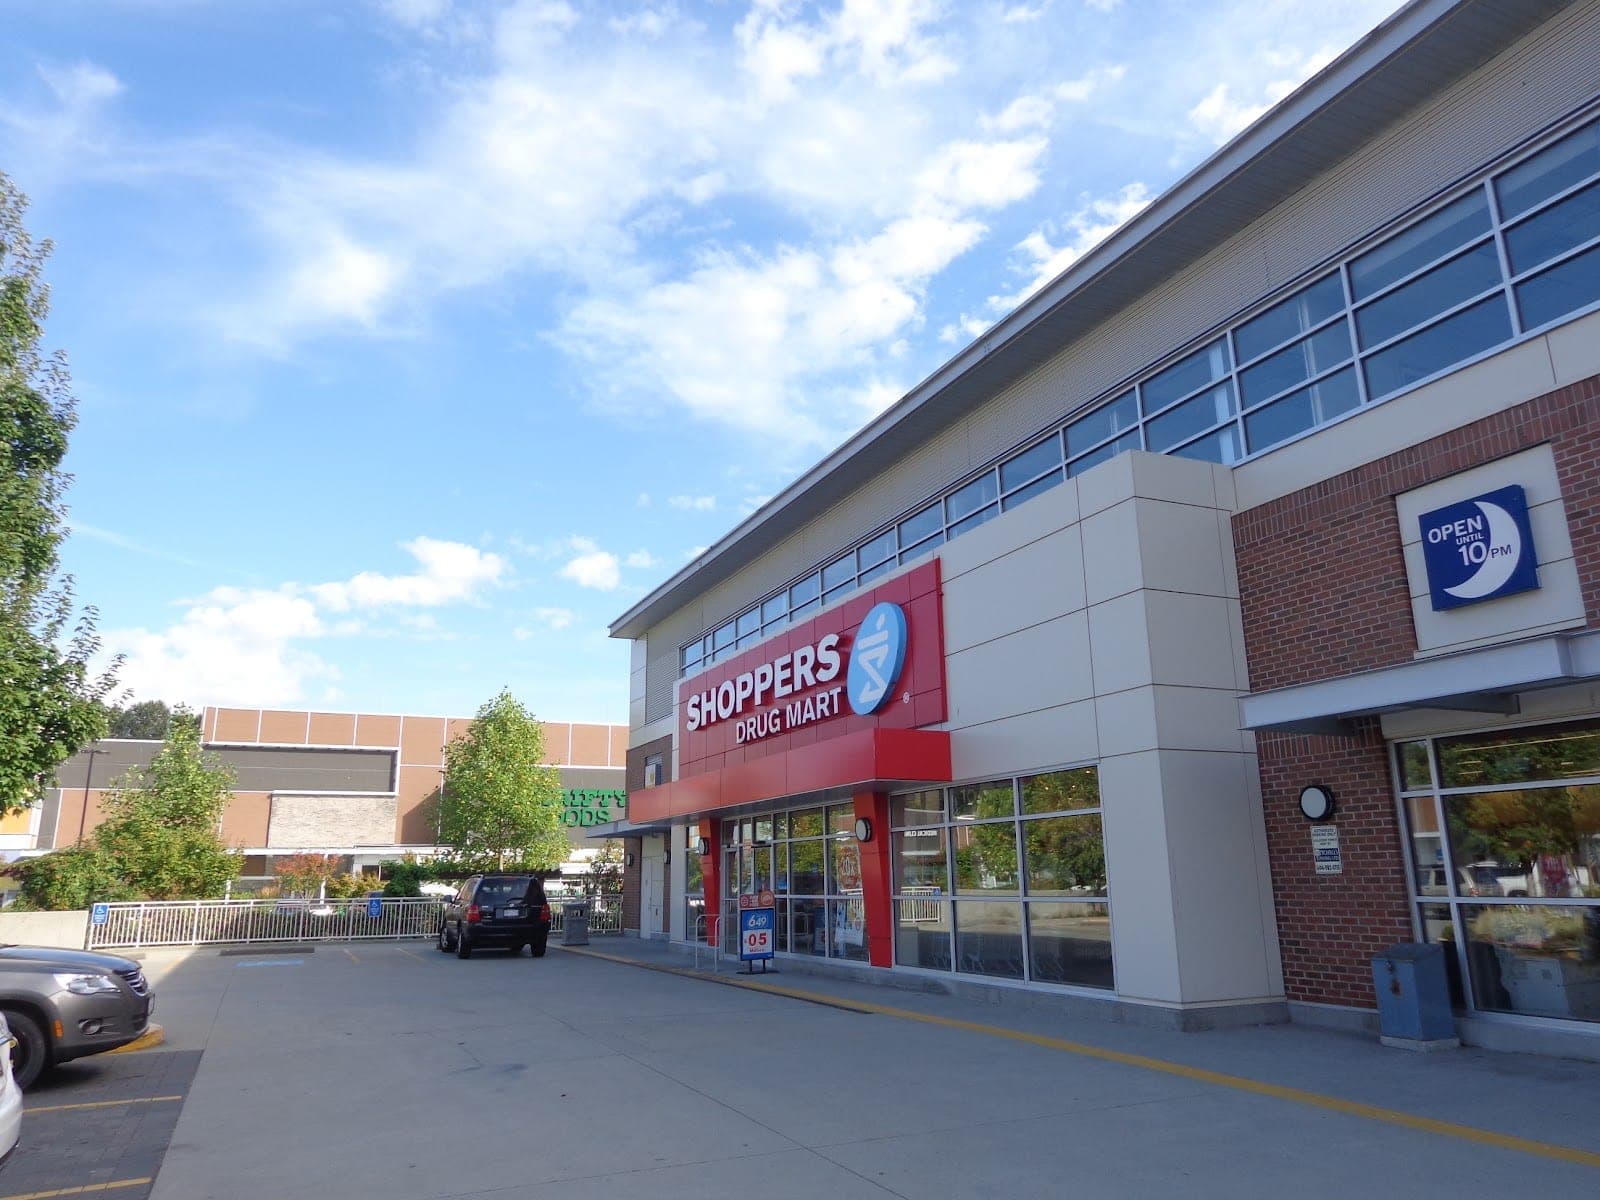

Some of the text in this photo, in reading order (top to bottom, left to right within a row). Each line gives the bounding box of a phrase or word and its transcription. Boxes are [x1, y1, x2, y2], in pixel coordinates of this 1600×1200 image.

[1428, 515, 1483, 544] OPEN
[1456, 532, 1485, 545] UNTIL
[1458, 541, 1512, 566] 10 PM
[686, 633, 841, 732] SHOPPERS
[735, 686, 842, 744] DRUG MART
[748, 914, 767, 927] 649
